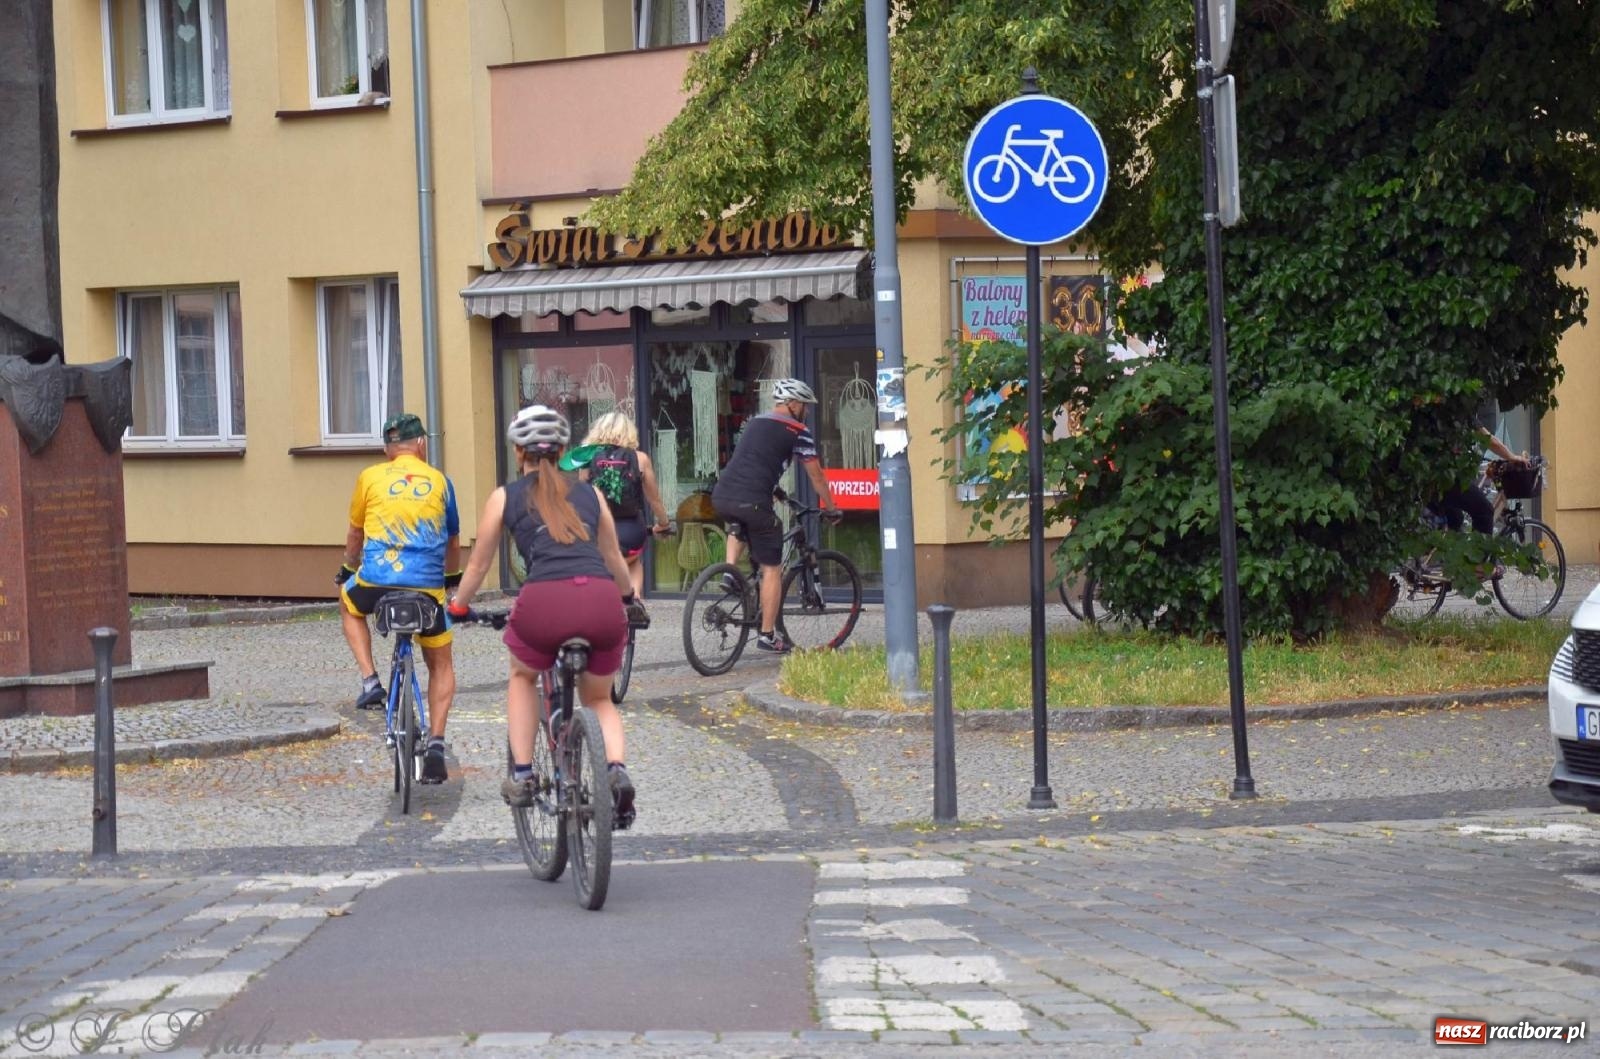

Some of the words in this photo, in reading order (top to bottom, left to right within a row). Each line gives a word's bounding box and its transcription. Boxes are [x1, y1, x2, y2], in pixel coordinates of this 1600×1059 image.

[964, 278, 1023, 308] Balony
[971, 310, 979, 326] z
[828, 481, 880, 496] YPRZEDA
[1588, 711, 1600, 737] G
